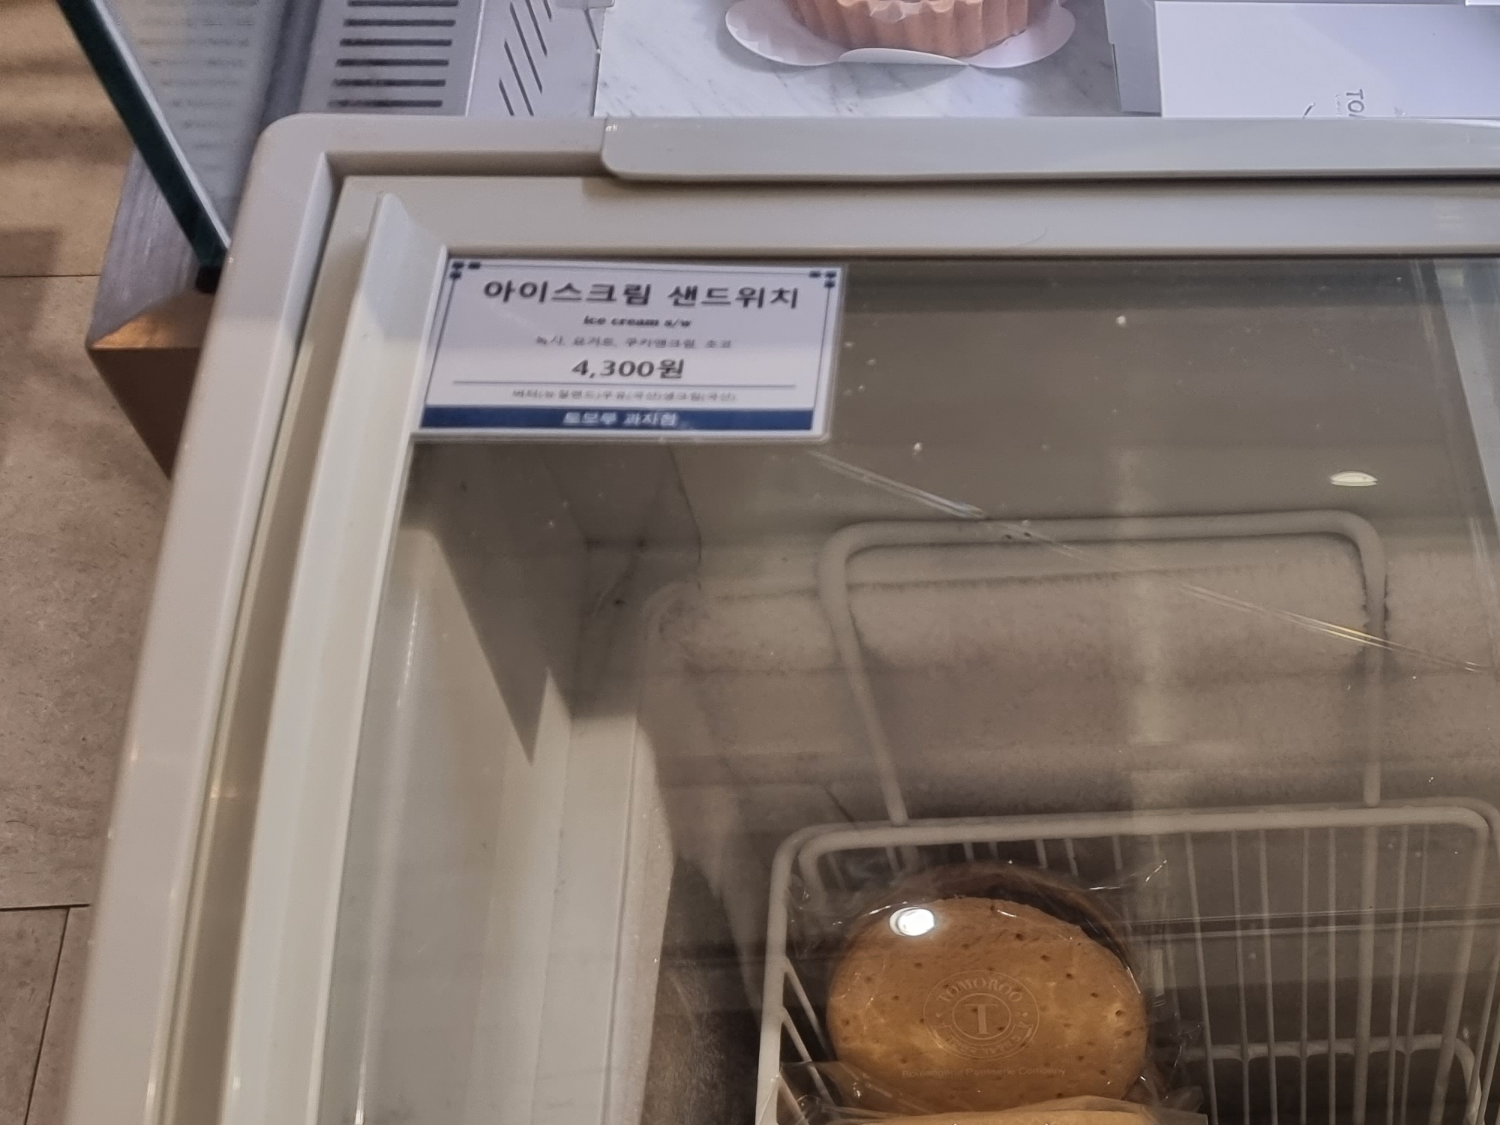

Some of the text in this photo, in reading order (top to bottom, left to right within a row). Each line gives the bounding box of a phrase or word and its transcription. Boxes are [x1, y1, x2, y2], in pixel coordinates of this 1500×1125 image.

[1346, 89, 1365, 117] TO
[483, 280, 799, 309] 아이스크림 샌드위치
[611, 316, 660, 327] cream
[572, 359, 685, 379] 4,300원
[937, 977, 1023, 1003] TOMOROO
